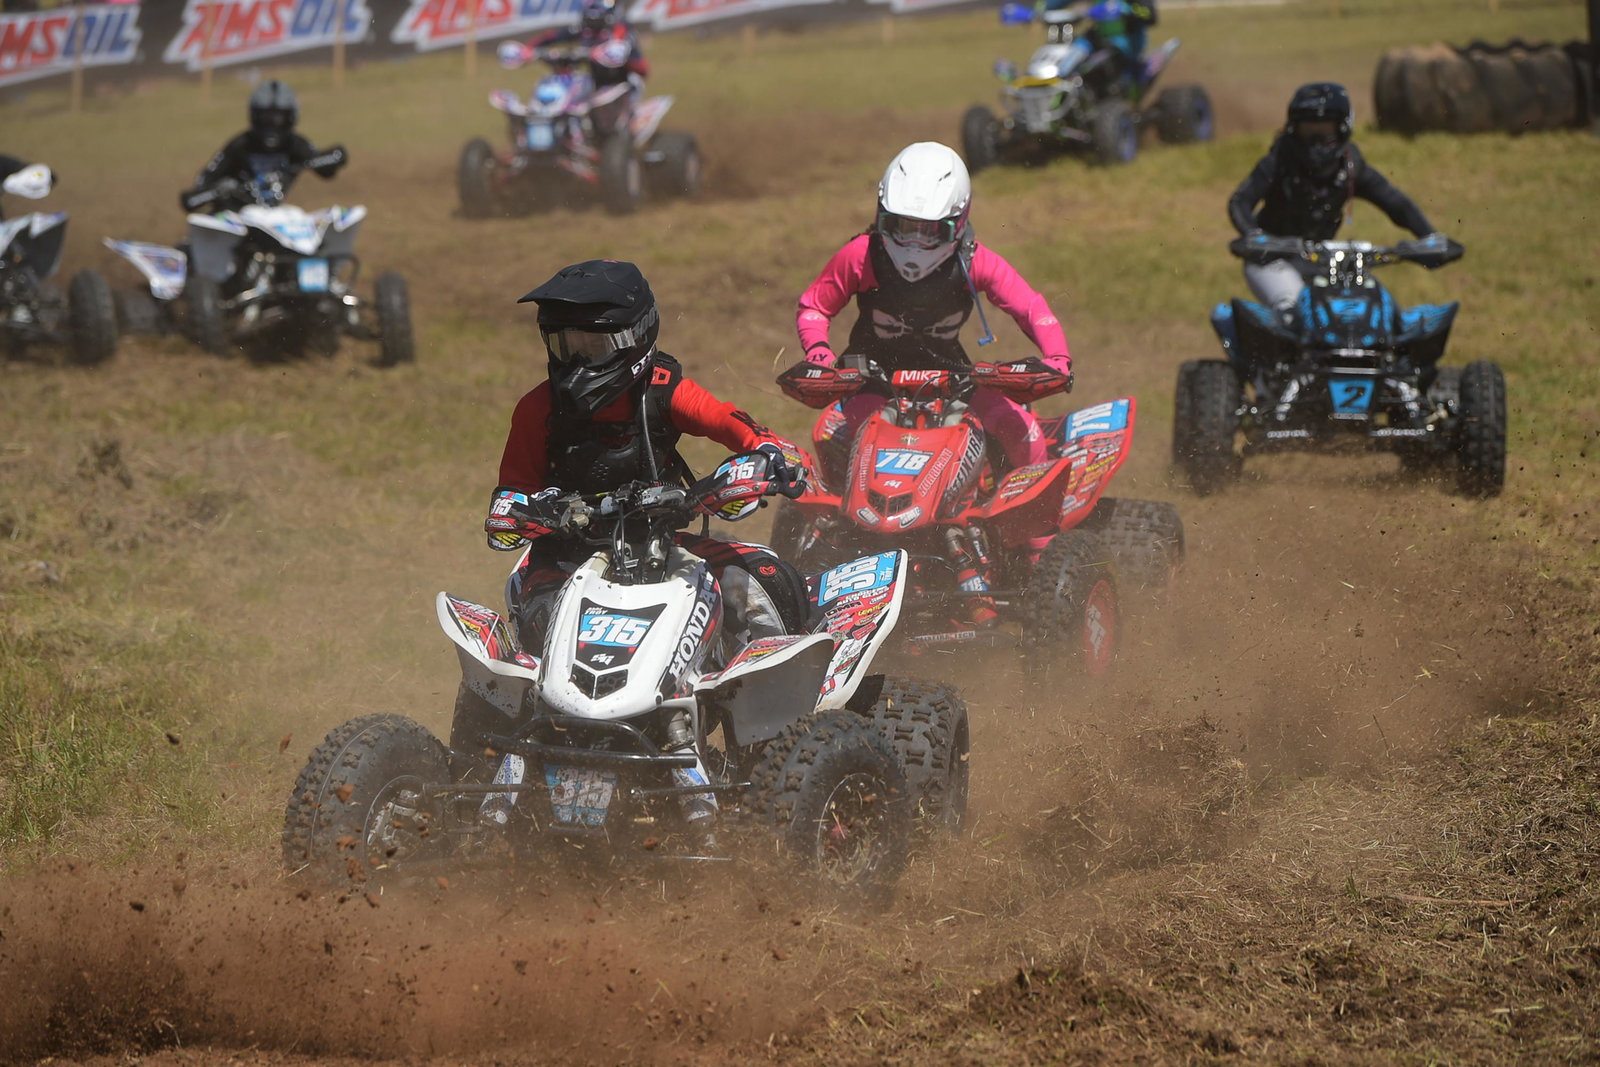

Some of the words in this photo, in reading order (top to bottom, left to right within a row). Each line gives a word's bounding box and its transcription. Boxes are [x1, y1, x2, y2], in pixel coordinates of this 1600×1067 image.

[178, 0, 362, 58] AMSOIL
[409, 0, 583, 39] AMS
[0, 12, 129, 76] MSOIL
[811, 353, 828, 362] LY
[1339, 387, 1366, 408] 2
[1069, 402, 1114, 439] 718
[727, 462, 755, 485] 315
[876, 452, 930, 470] 718
[823, 556, 880, 601] 315
[578, 616, 652, 645] 315
[669, 588, 717, 680] HONDA
